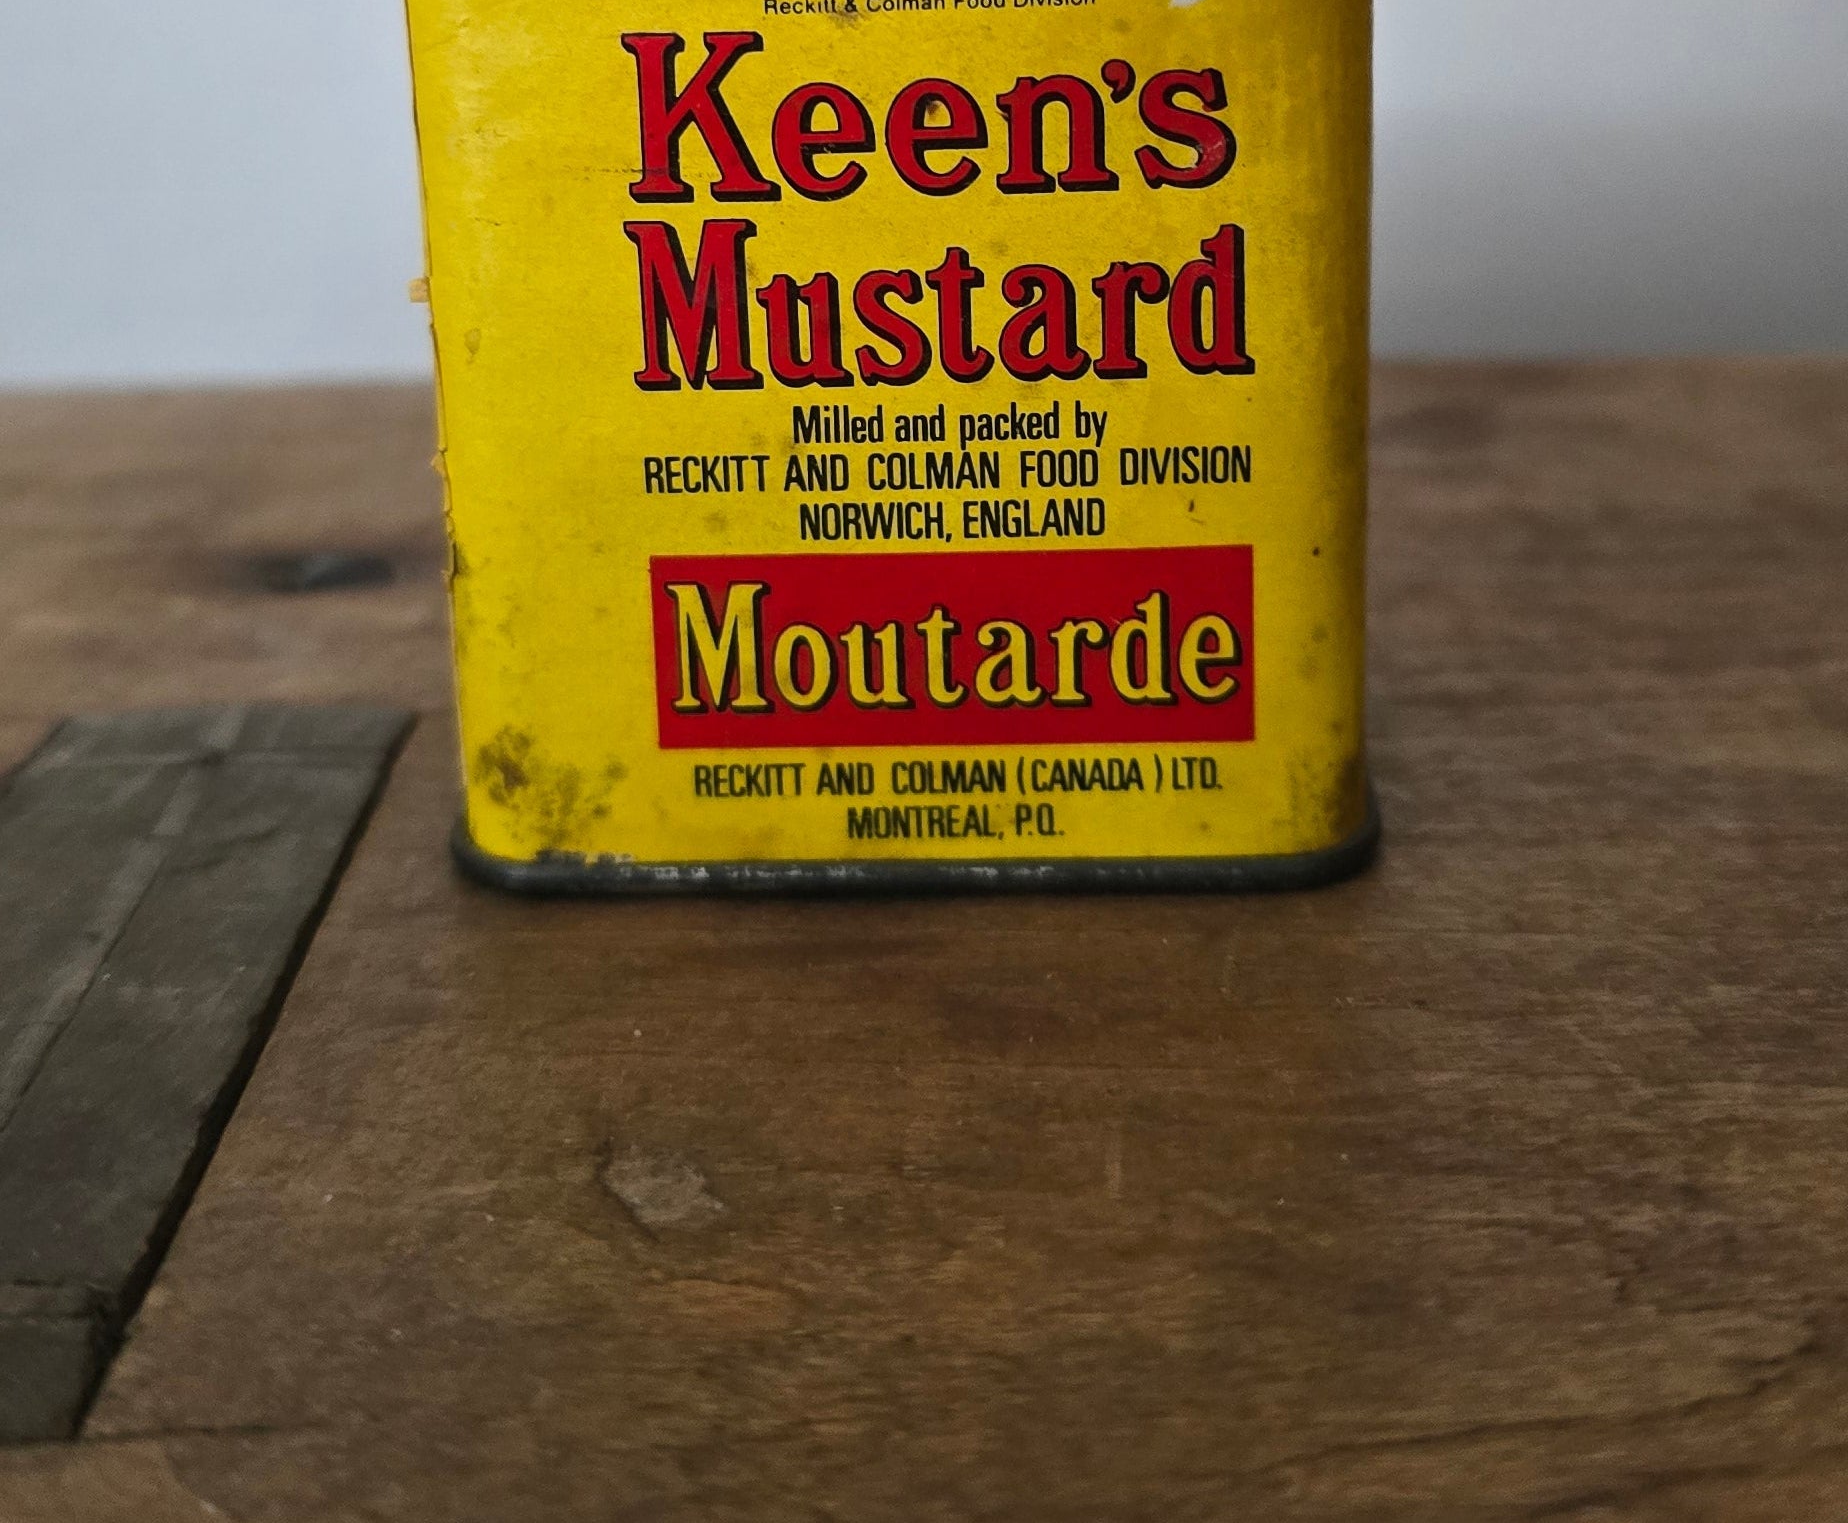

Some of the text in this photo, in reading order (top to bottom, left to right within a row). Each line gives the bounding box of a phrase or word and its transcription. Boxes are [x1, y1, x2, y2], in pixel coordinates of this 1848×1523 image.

[621, 31, 1236, 202] Keen's
[623, 218, 1255, 391] Mustard
[793, 401, 1107, 450] Milled and packed by
[644, 445, 1252, 494] RECKITT AND COLMAN FOOD DIVISION
[800, 497, 1105, 543] NORWICH, ENGLAND
[664, 580, 1241, 714] Moutarde
[694, 763, 805, 798] RECKITT
[817, 761, 874, 795] AND
[892, 759, 1006, 794] COLMAN
[1172, 756, 1223, 791] LTD.
[848, 803, 1066, 843] MONTREAL, P.Q.
